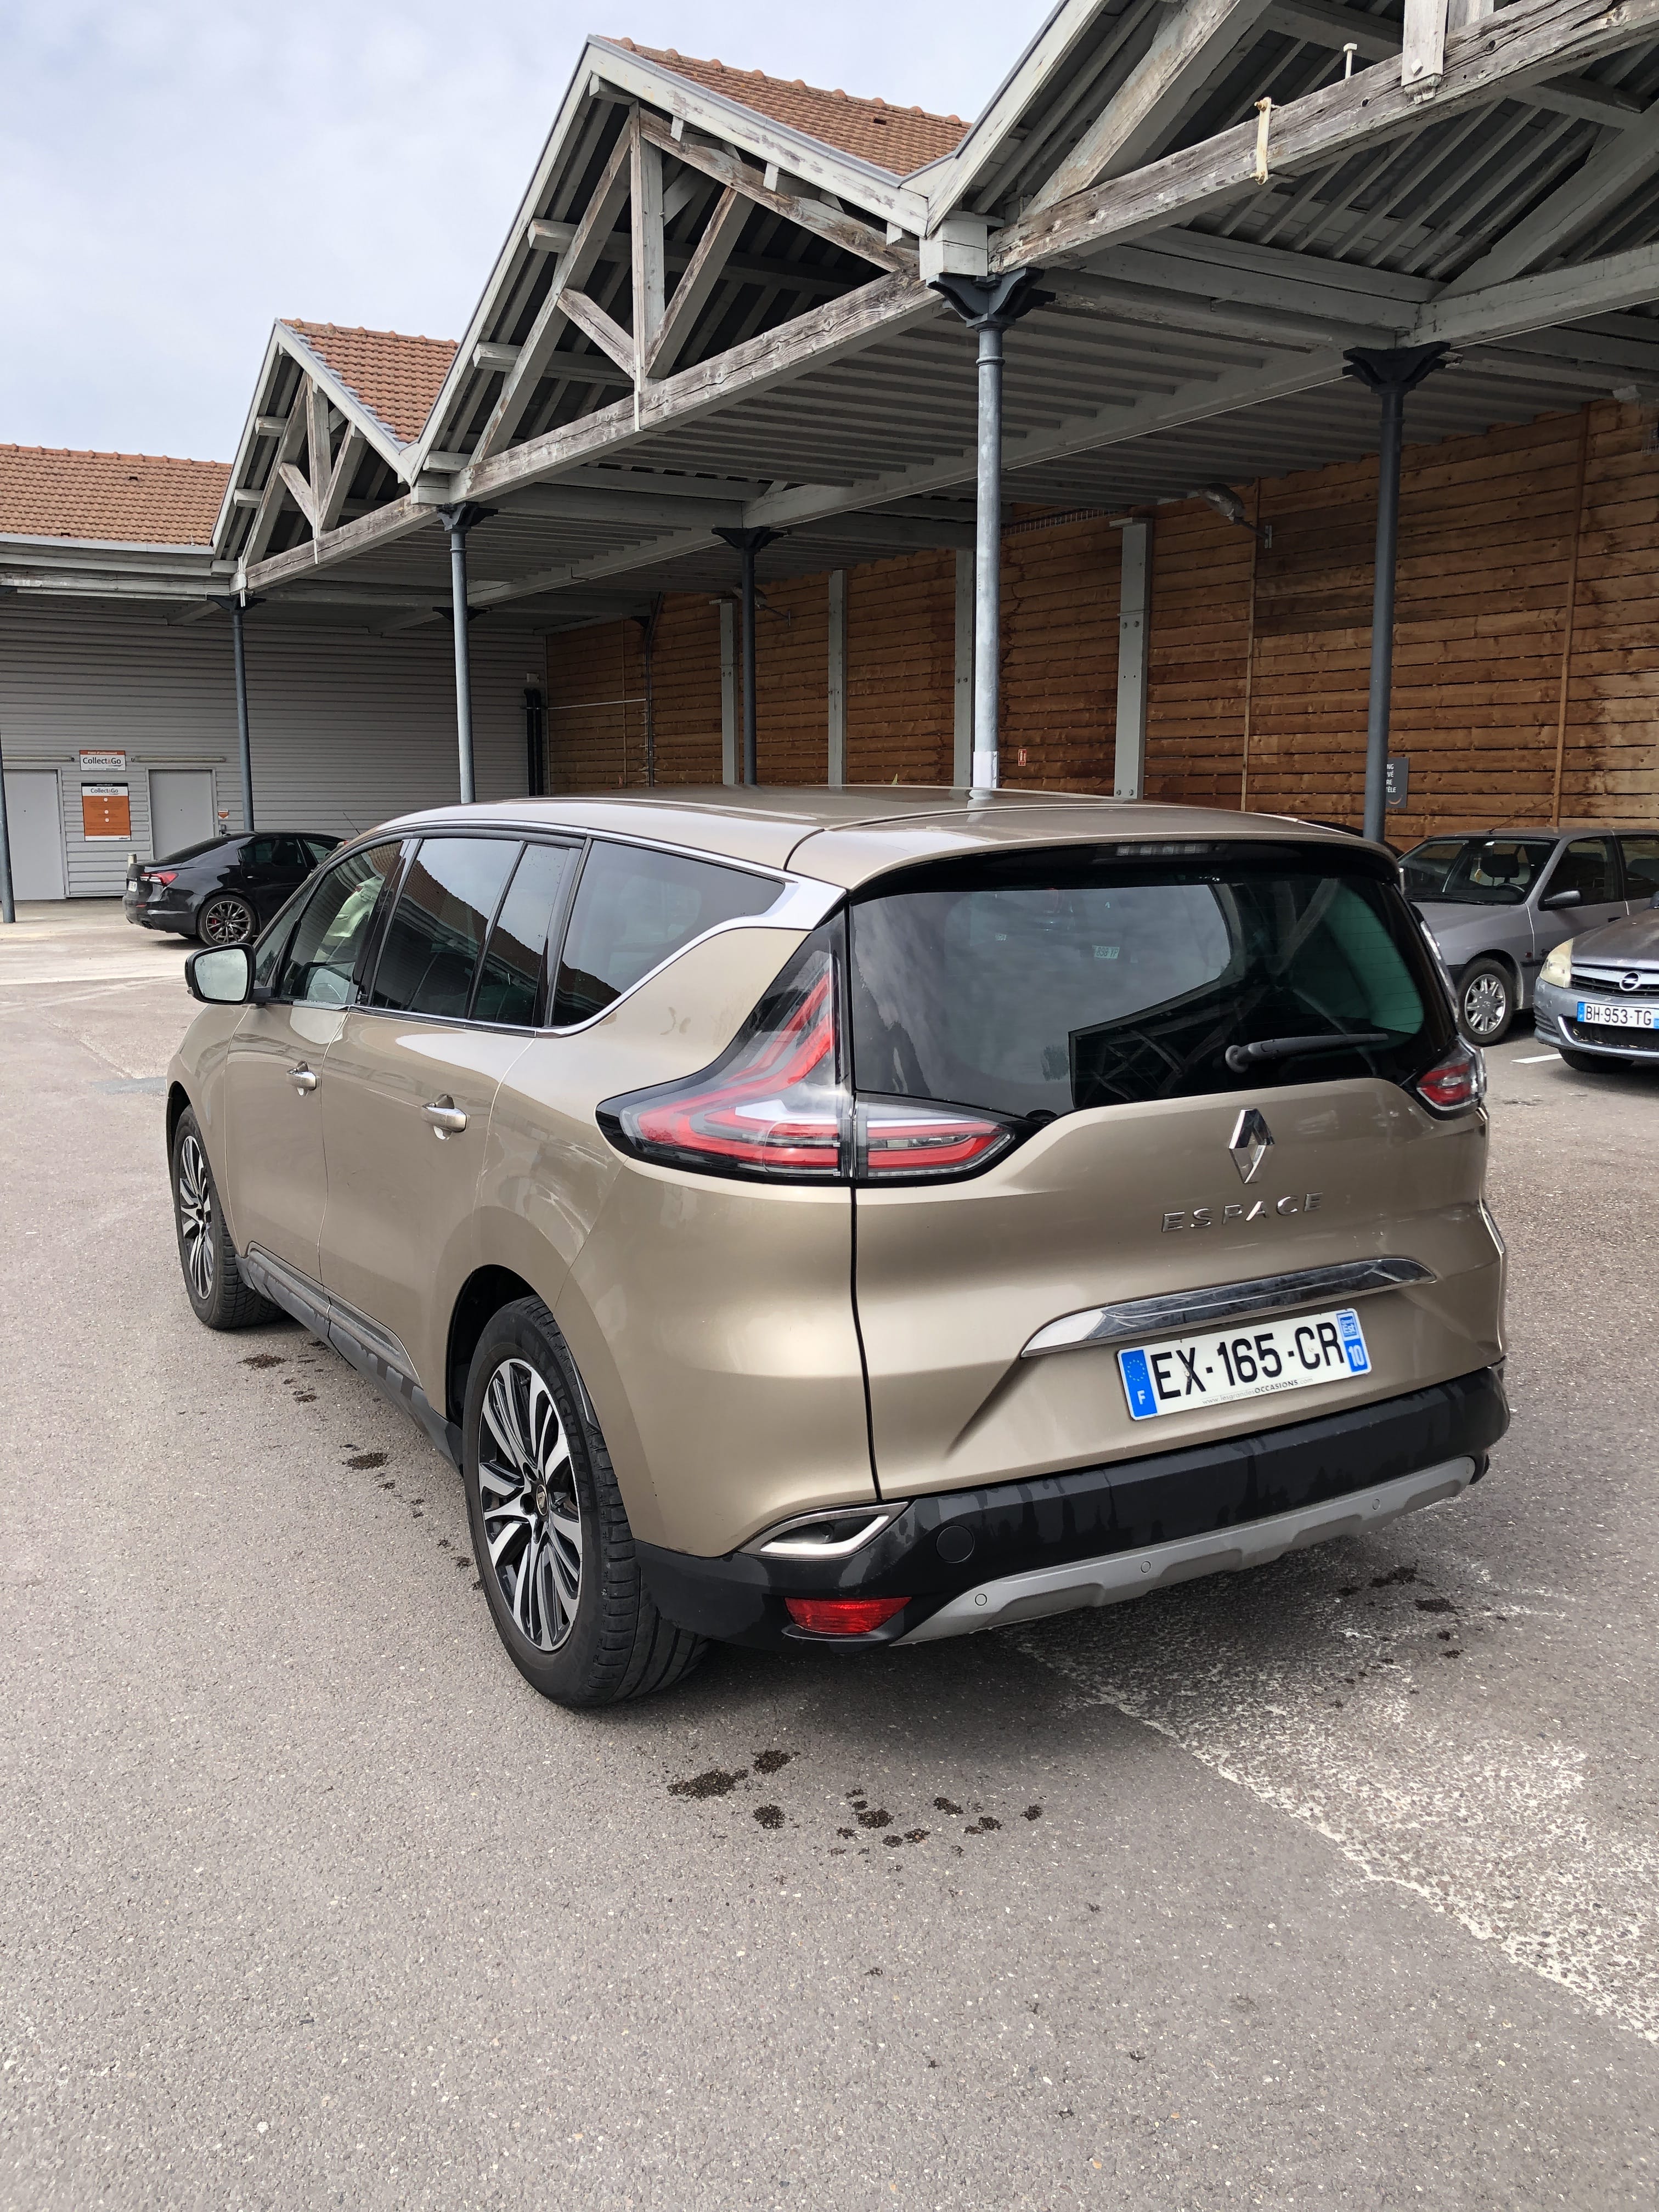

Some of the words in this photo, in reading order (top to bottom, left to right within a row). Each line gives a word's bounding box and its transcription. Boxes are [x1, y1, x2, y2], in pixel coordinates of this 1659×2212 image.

[1586, 1006, 1651, 1025] BH-953-TG
[1161, 1192, 1323, 1233] ESPACE
[1137, 1390, 1146, 1404] F
[1150, 1322, 1345, 1400] EX-165-CR
[1348, 1345, 1365, 1367] 10
[548, 1365, 593, 1511] MICHELIN
